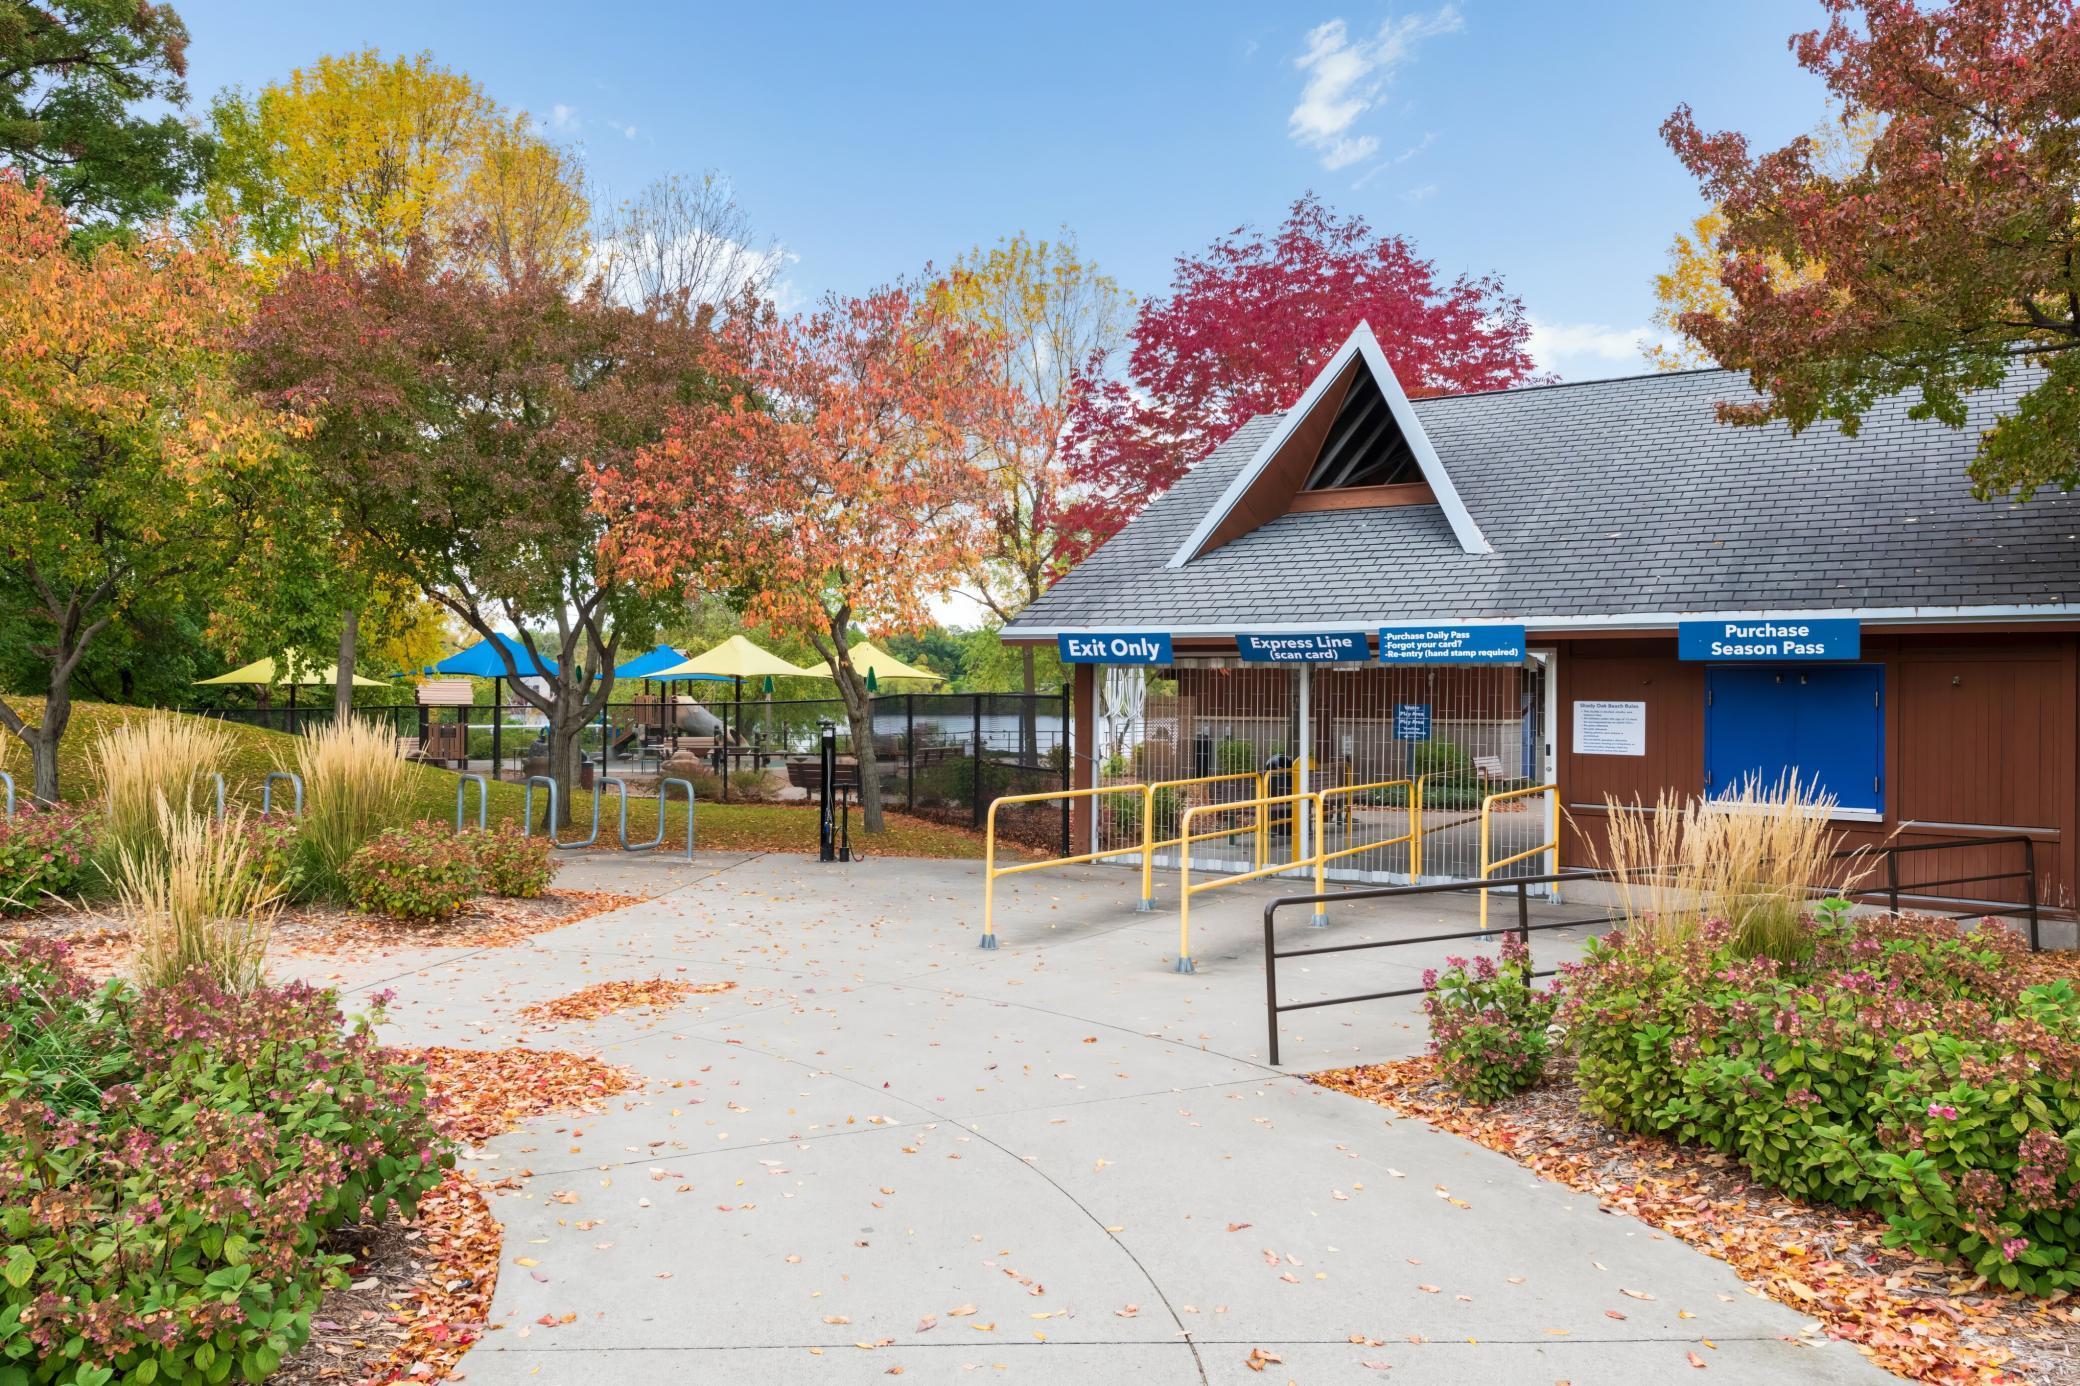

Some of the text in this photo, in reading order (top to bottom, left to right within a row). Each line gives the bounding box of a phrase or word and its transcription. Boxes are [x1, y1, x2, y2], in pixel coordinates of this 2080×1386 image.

[1384, 631, 1470, 641] -Purchase Daily Pass
[1725, 623, 1809, 638] Purchase
[1068, 637, 1160, 661] Exit Only
[1250, 635, 1352, 651] Express Line
[1384, 642, 1415, 650] -Forgot
[1417, 642, 1436, 650] your
[1711, 641, 1825, 656] Season Pass
[1269, 648, 1338, 660] (scan card)
[1384, 648, 1519, 659] -Re-entry (hand stamp required)
